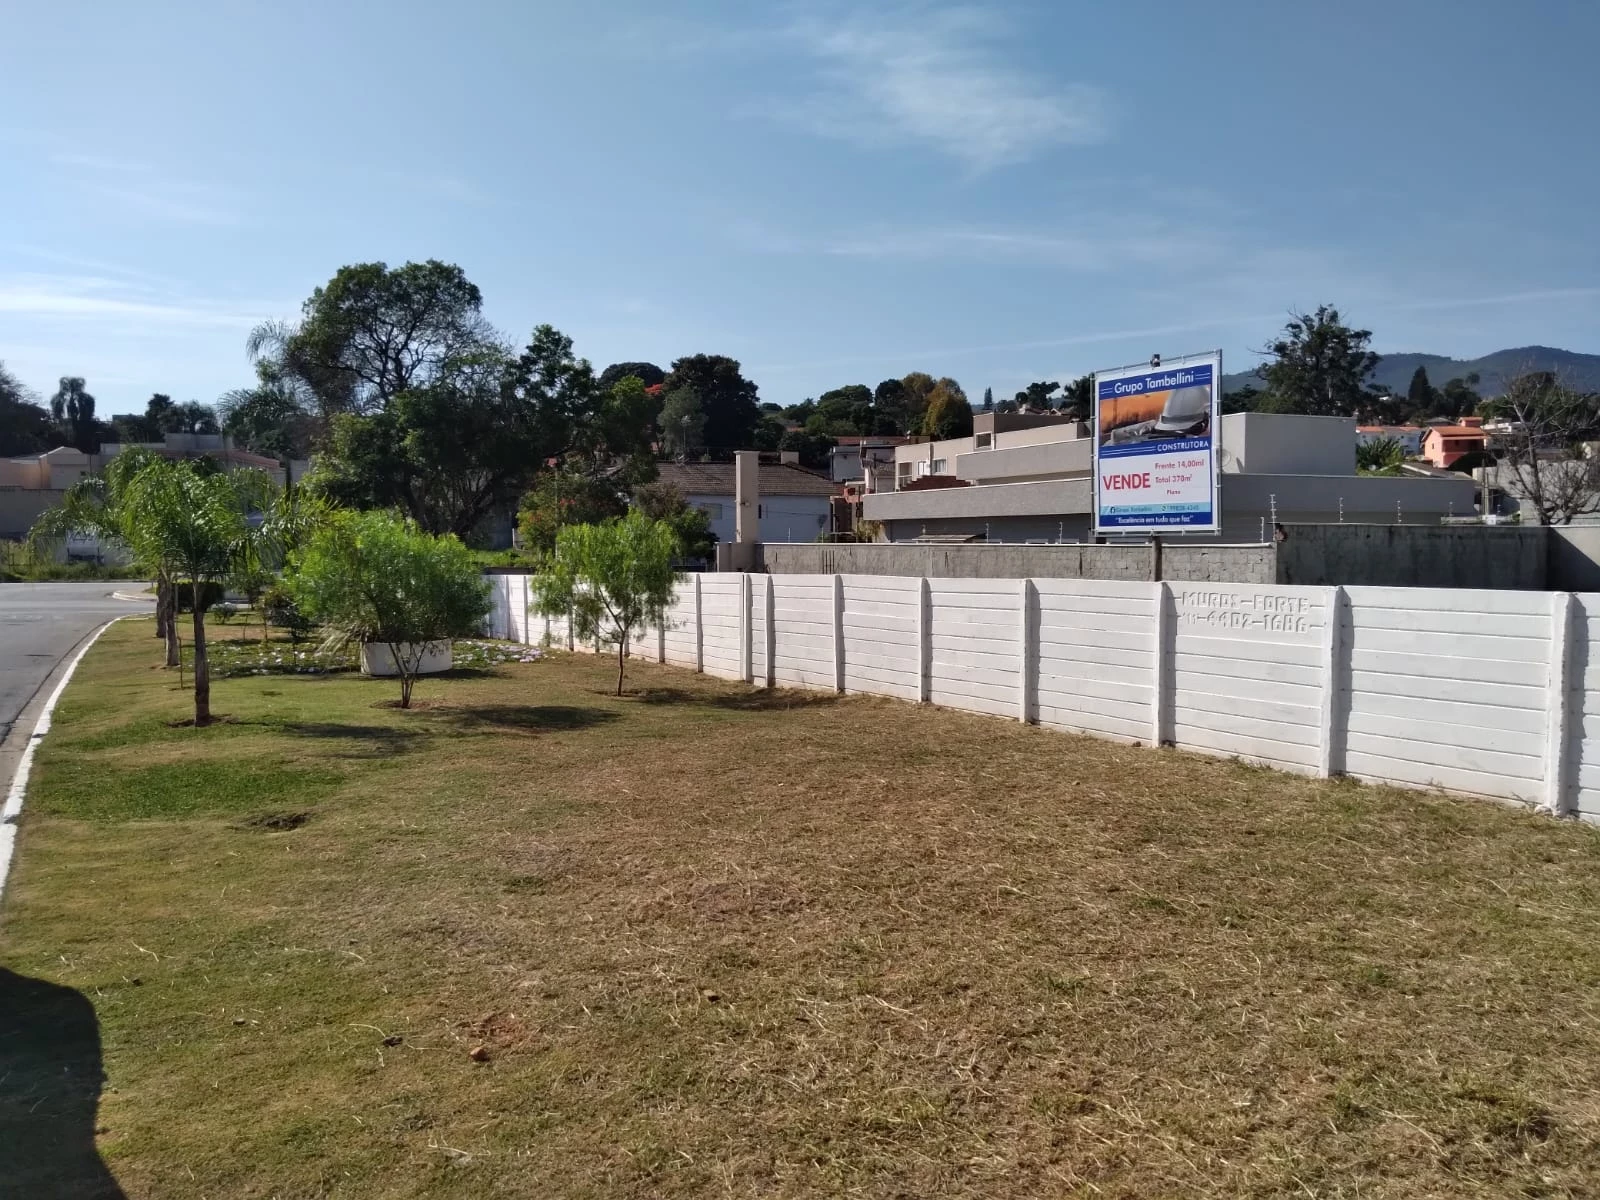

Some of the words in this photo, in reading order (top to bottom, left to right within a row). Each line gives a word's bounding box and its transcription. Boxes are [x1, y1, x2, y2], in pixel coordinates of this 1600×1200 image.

[1114, 381, 1143, 395] Grupo
[1146, 371, 1194, 389] Tambellini
[1157, 440, 1209, 452] CONSTRUTORA
[1155, 462, 1176, 470] Frente
[1103, 472, 1151, 491] VENDE
[1155, 475, 1171, 483] Total
